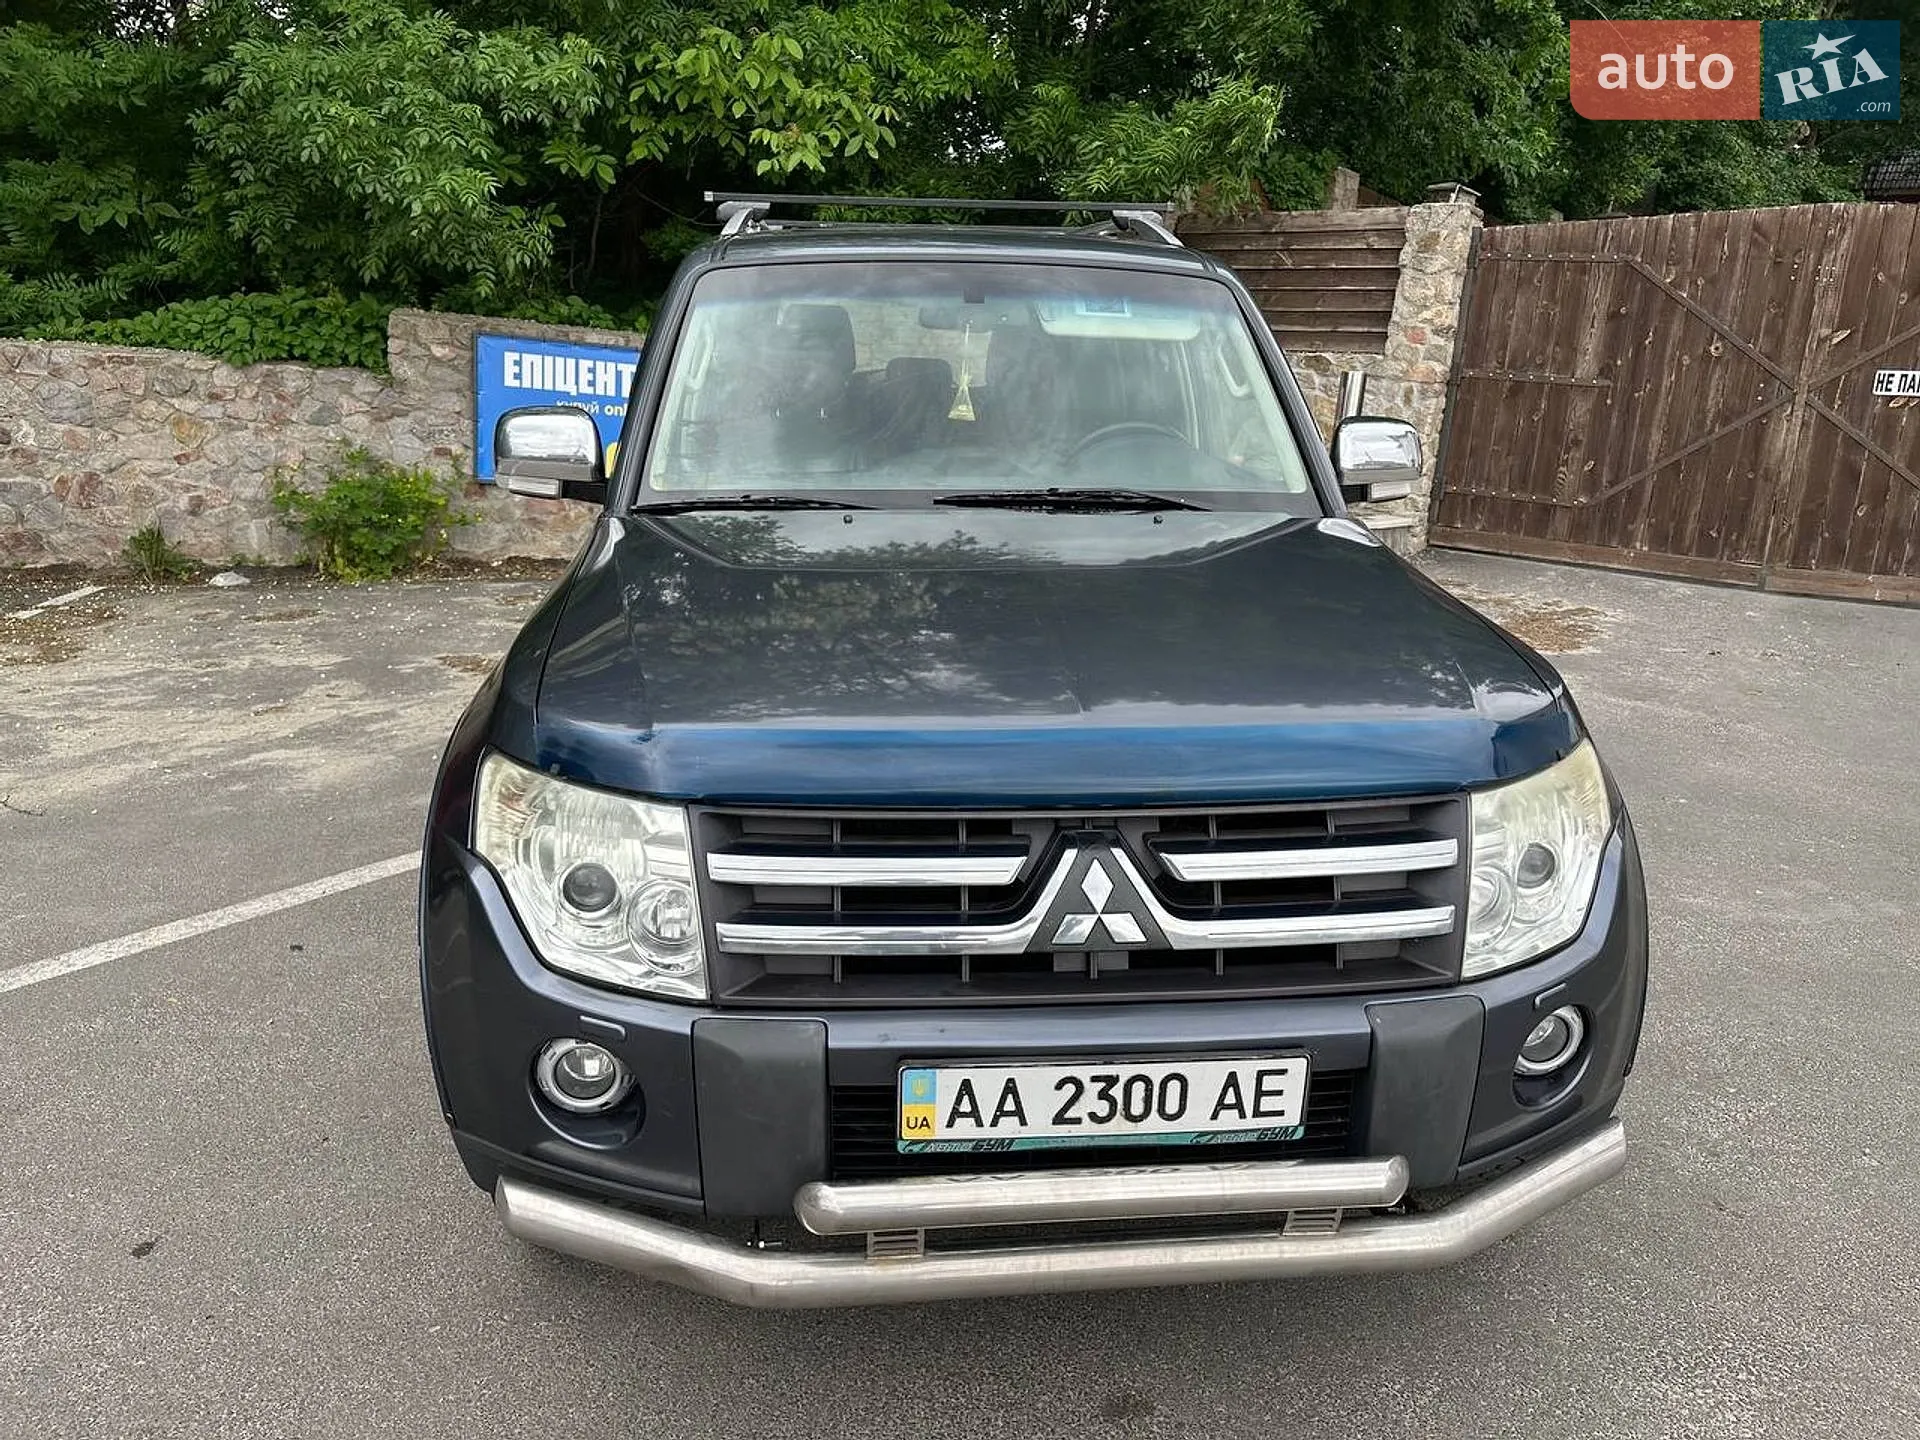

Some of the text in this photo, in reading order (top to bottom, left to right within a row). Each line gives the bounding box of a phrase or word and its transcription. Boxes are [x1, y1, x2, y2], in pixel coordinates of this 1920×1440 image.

[1875, 373, 1895, 393] НЕ
[945, 1068, 1288, 1129] AA 2300 AE
[906, 1115, 931, 1131] UA
